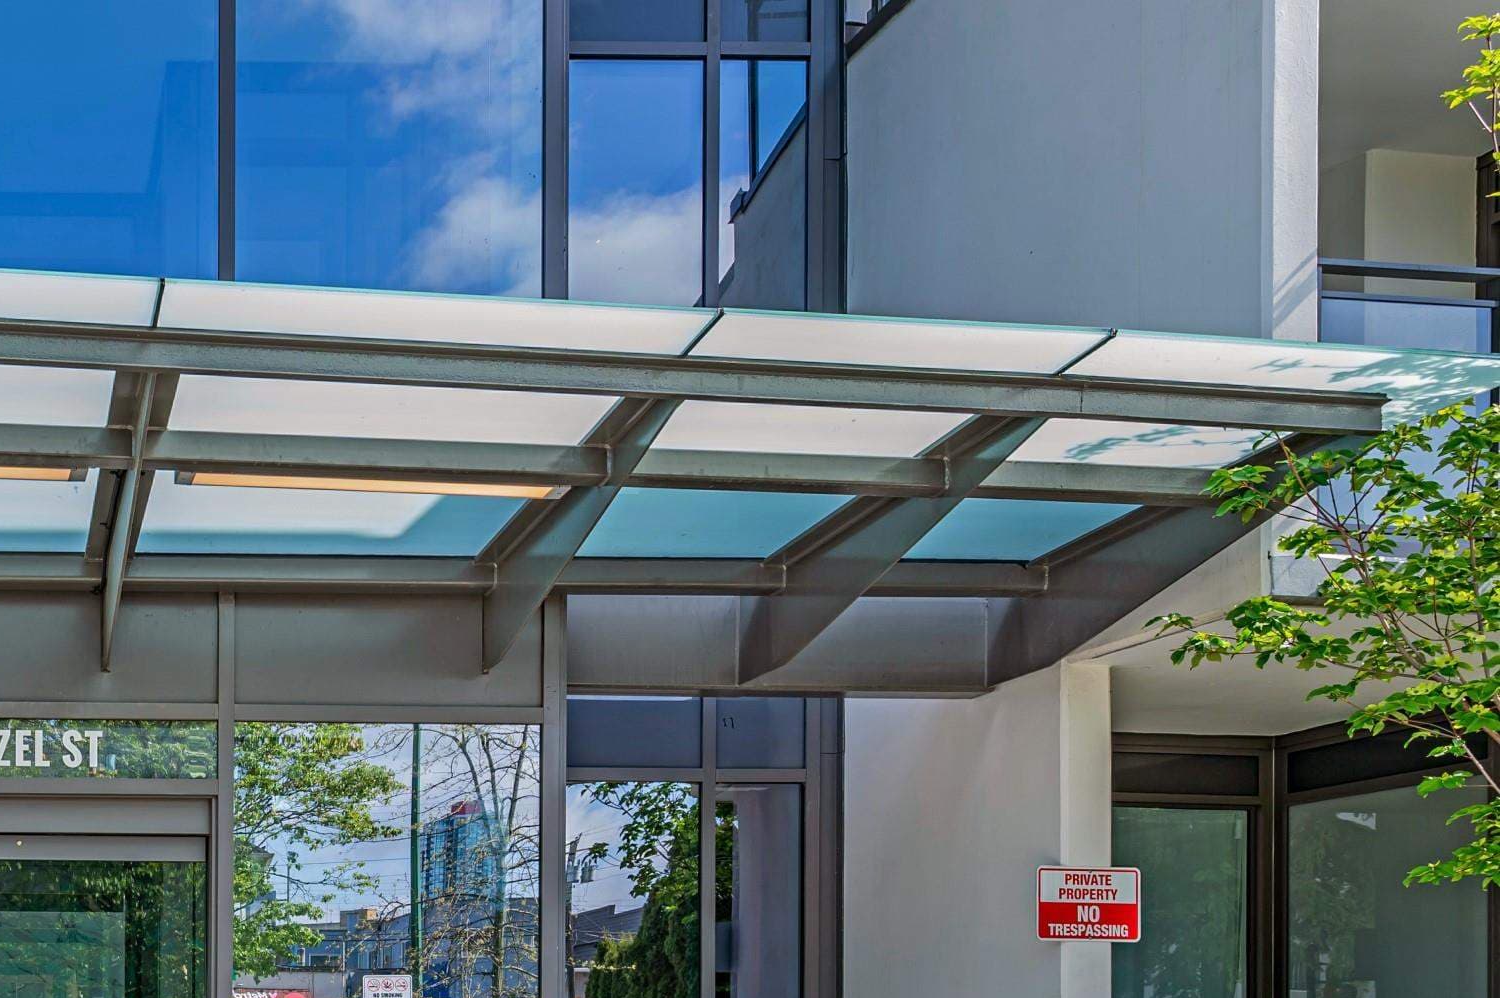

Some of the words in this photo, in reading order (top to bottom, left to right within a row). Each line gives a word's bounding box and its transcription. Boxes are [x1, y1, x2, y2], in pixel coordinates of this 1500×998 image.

[62, 729, 103, 769] ST
[1064, 873, 1112, 886] PRIVATE
[1058, 887, 1118, 901] PROPERTY
[1077, 905, 1101, 923] NO
[1047, 923, 1129, 937] TRESPASSING
